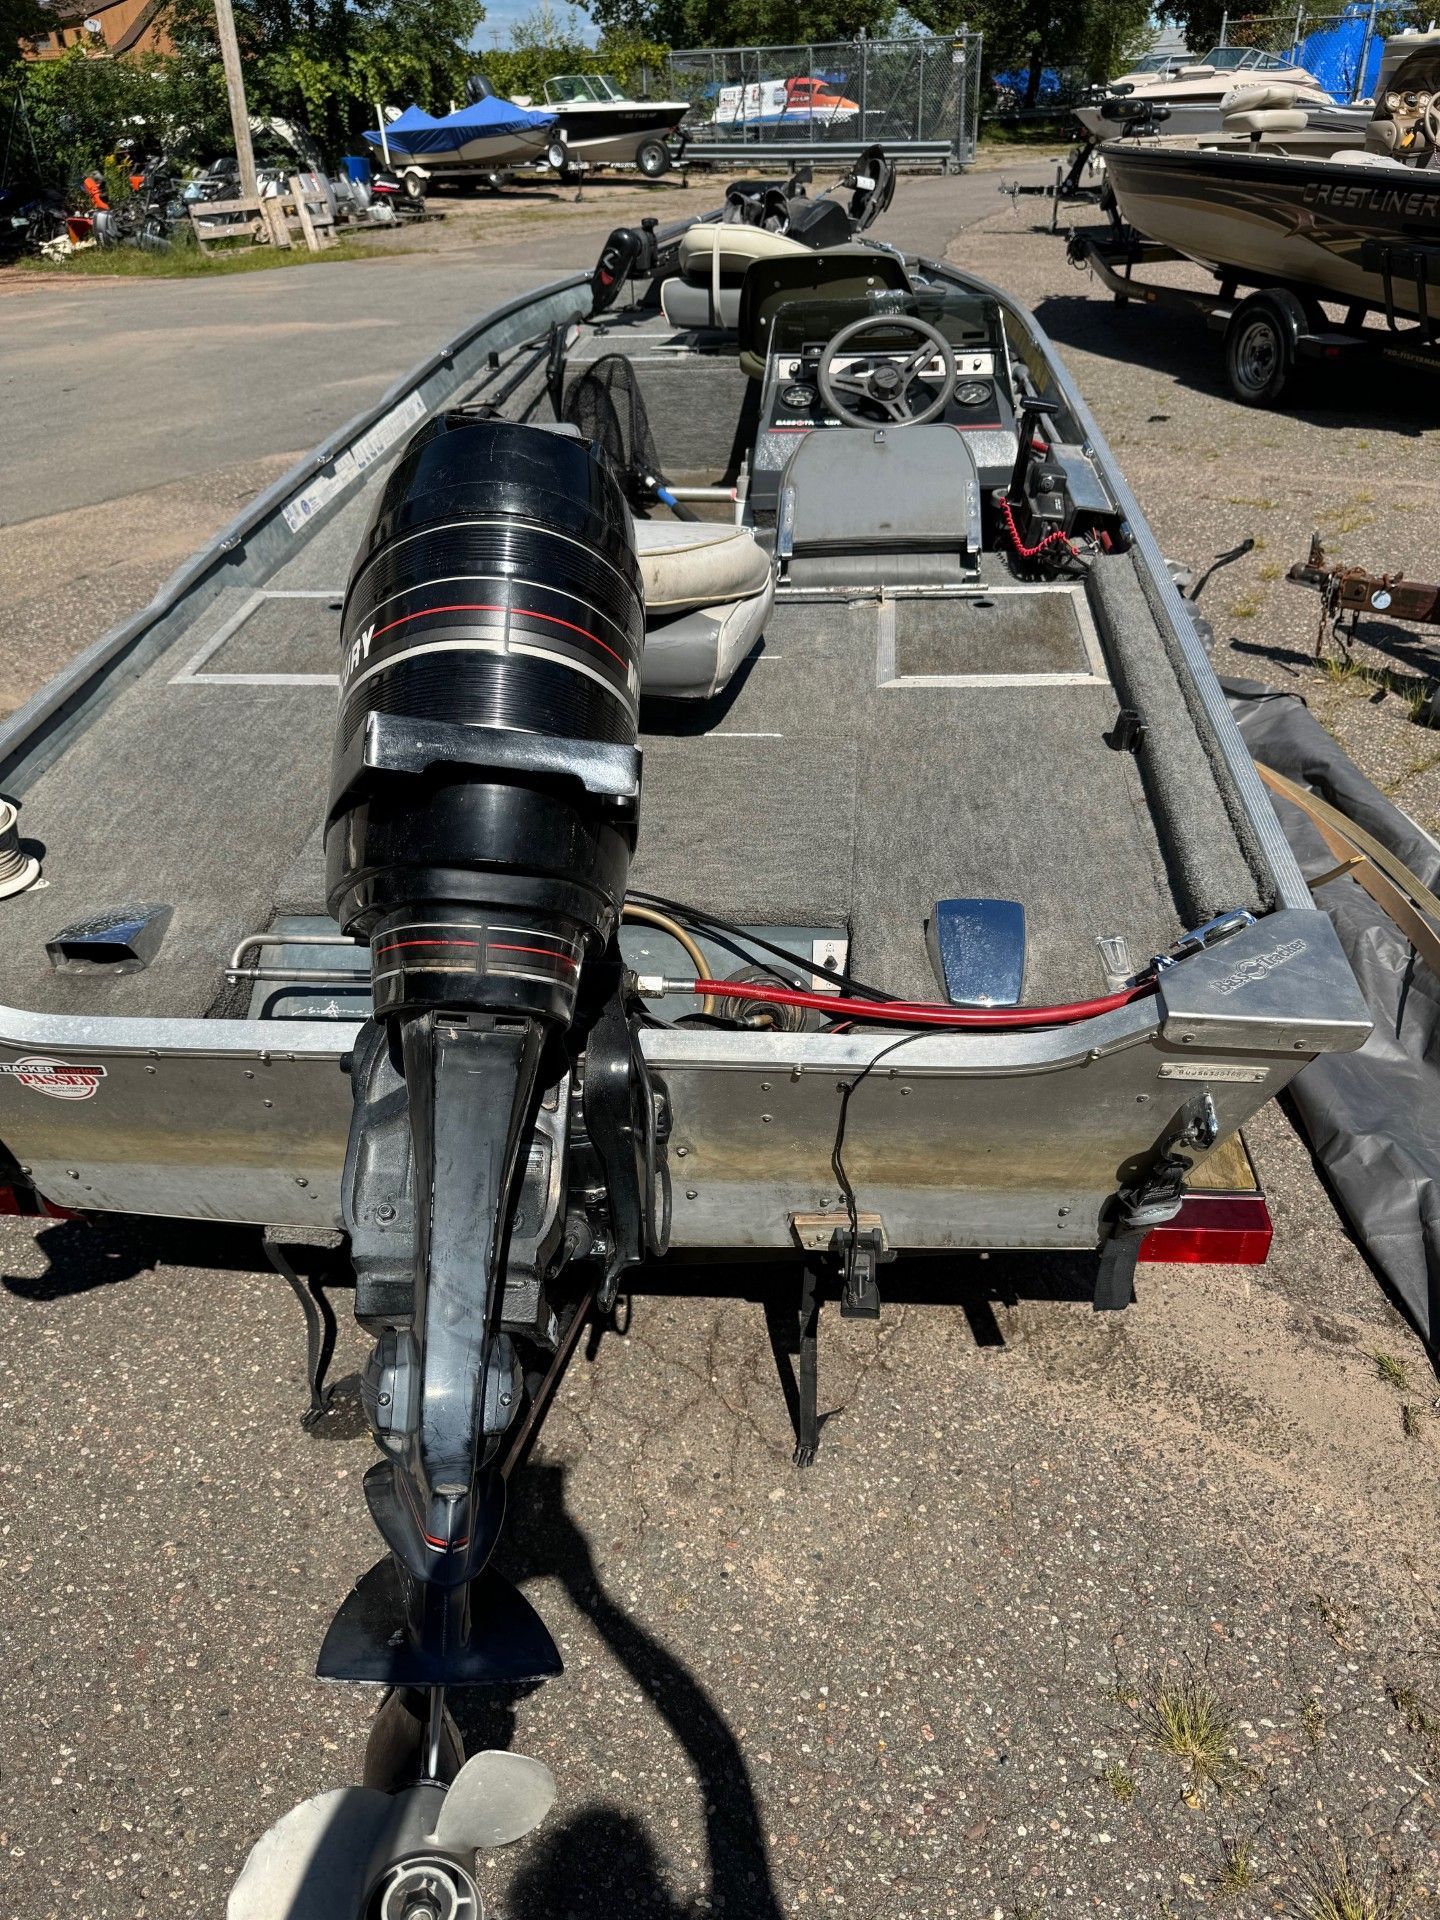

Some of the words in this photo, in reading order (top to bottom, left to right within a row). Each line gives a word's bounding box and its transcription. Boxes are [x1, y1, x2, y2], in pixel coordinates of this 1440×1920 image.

[1303, 183, 1440, 217] CRESTLINER
[1212, 972, 1250, 993] Bass
[1255, 939, 1307, 968] Tracker
[18, 1074, 97, 1086] PASSED
